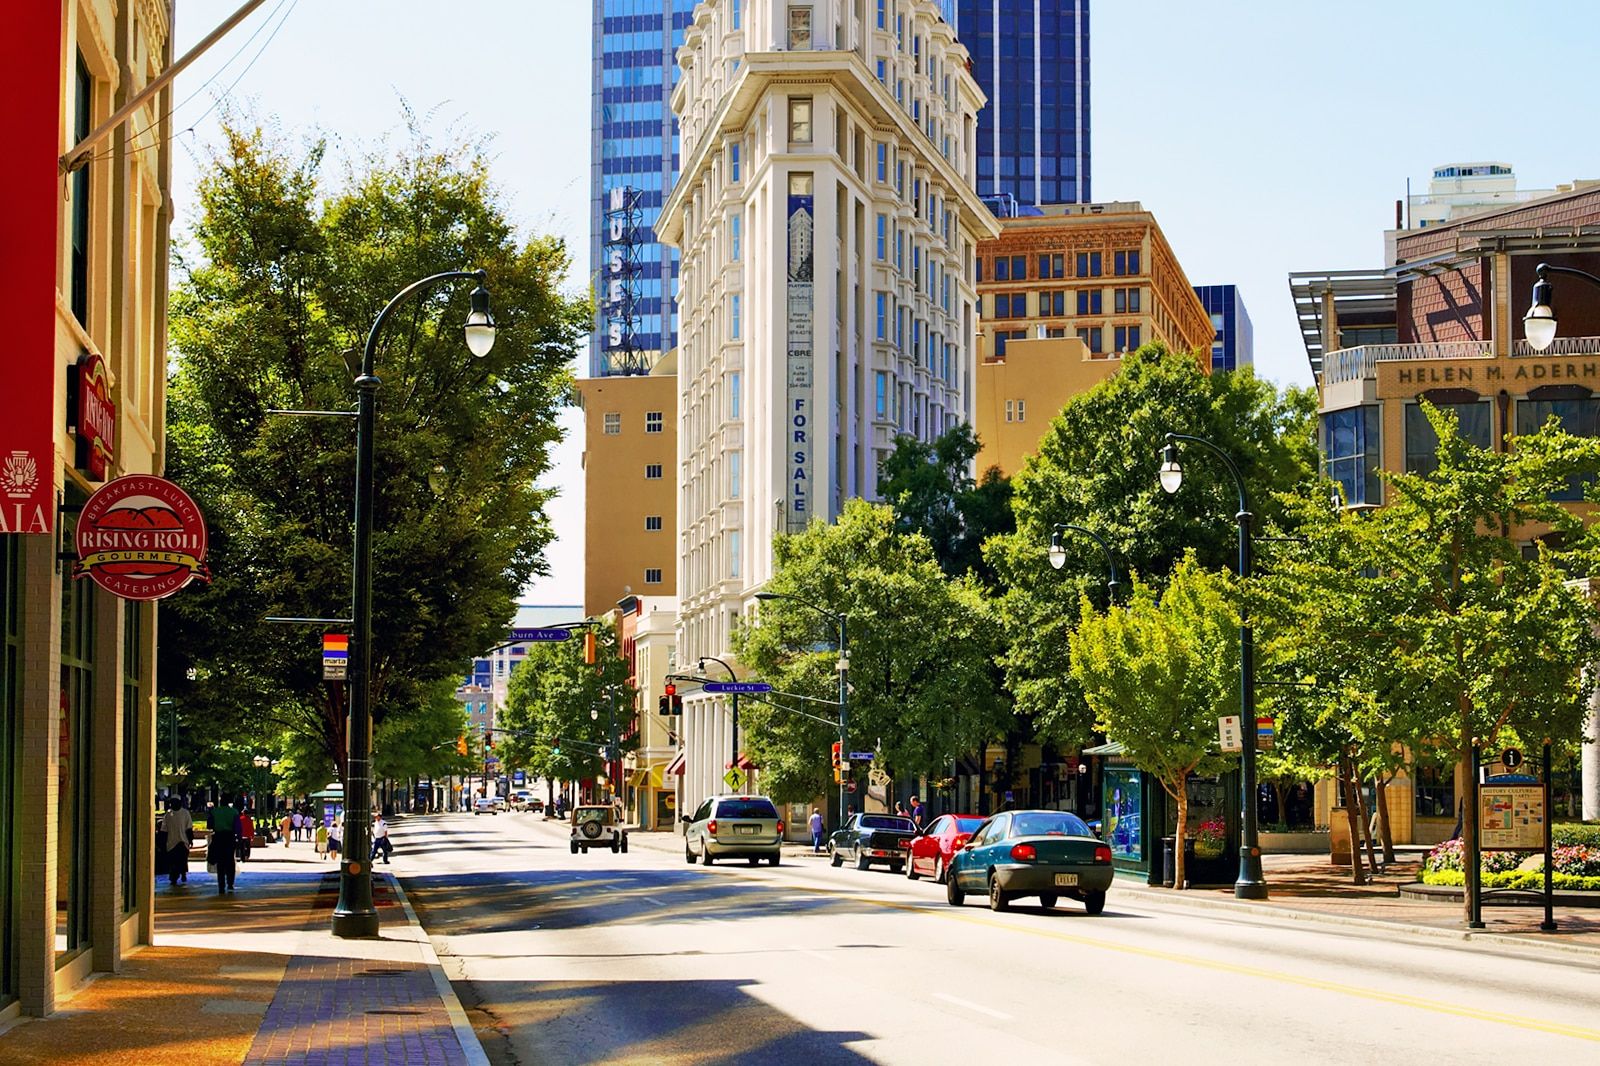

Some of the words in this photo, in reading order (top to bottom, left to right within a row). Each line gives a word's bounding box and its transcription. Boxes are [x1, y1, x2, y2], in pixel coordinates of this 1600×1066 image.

[1400, 367, 1473, 383] HELEN
[1486, 366, 1505, 380] M.
[1514, 363, 1596, 380] ADERH
[793, 399, 806, 443] FOR
[793, 451, 806, 511] SALE
[88, 482, 154, 520] BREAKFAST
[163, 489, 195, 523] LUNCH
[82, 531, 149, 549] RISING
[154, 532, 201, 550] ROLL
[97, 552, 184, 562] GOURMET
[105, 576, 176, 593] CATERING
[537, 631, 554, 639] Ave
